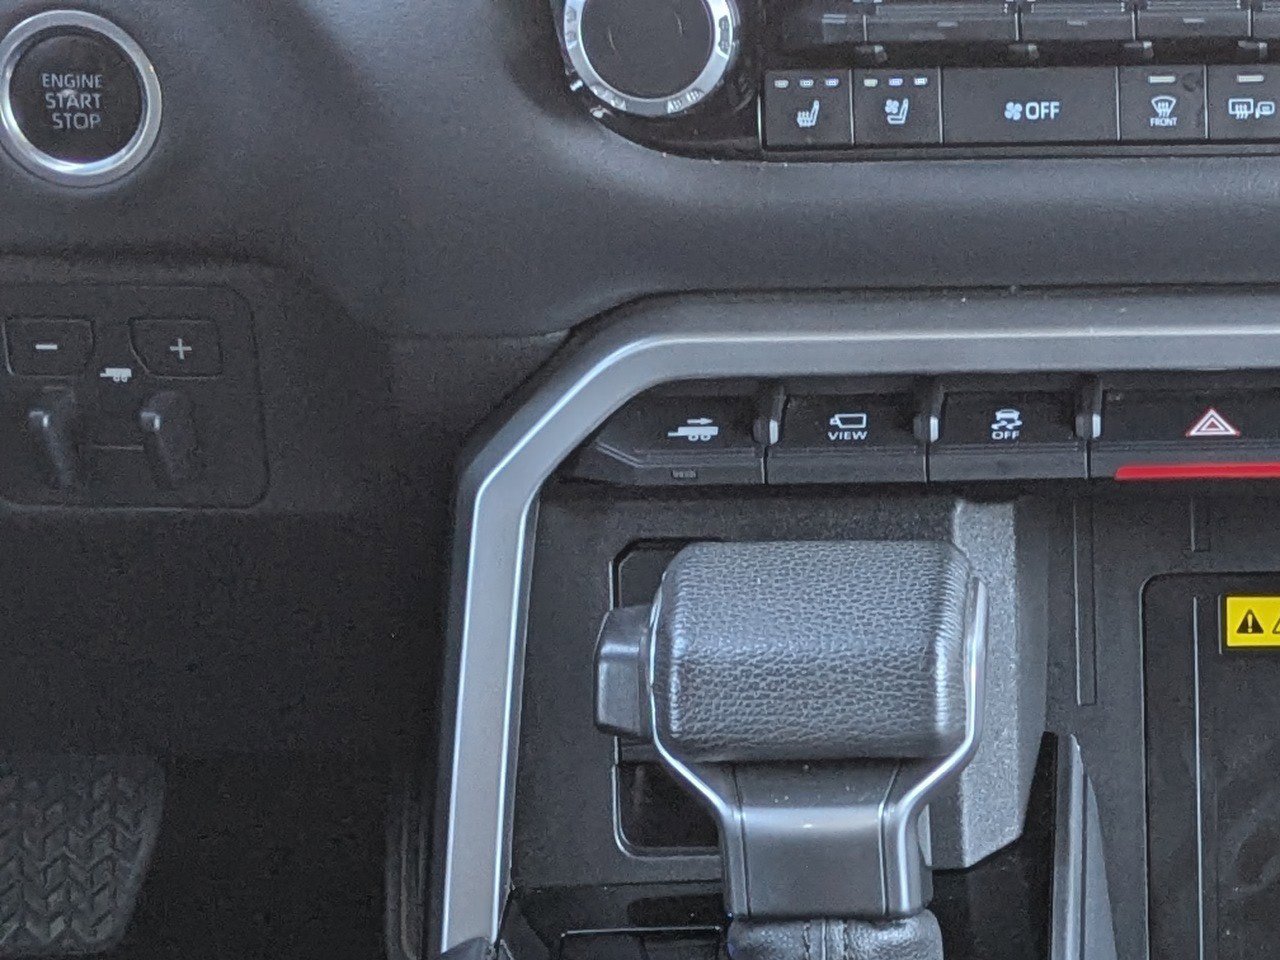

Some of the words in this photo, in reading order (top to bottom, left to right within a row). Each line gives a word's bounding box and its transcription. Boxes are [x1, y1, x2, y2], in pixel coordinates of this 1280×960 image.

[42, 73, 103, 88] ENGINE
[45, 92, 102, 109] START
[1025, 101, 1060, 120] OFF
[52, 112, 102, 129] STOP
[1150, 117, 1177, 127] FRONT
[828, 431, 868, 441] VIEW
[991, 431, 1020, 440] OFF
